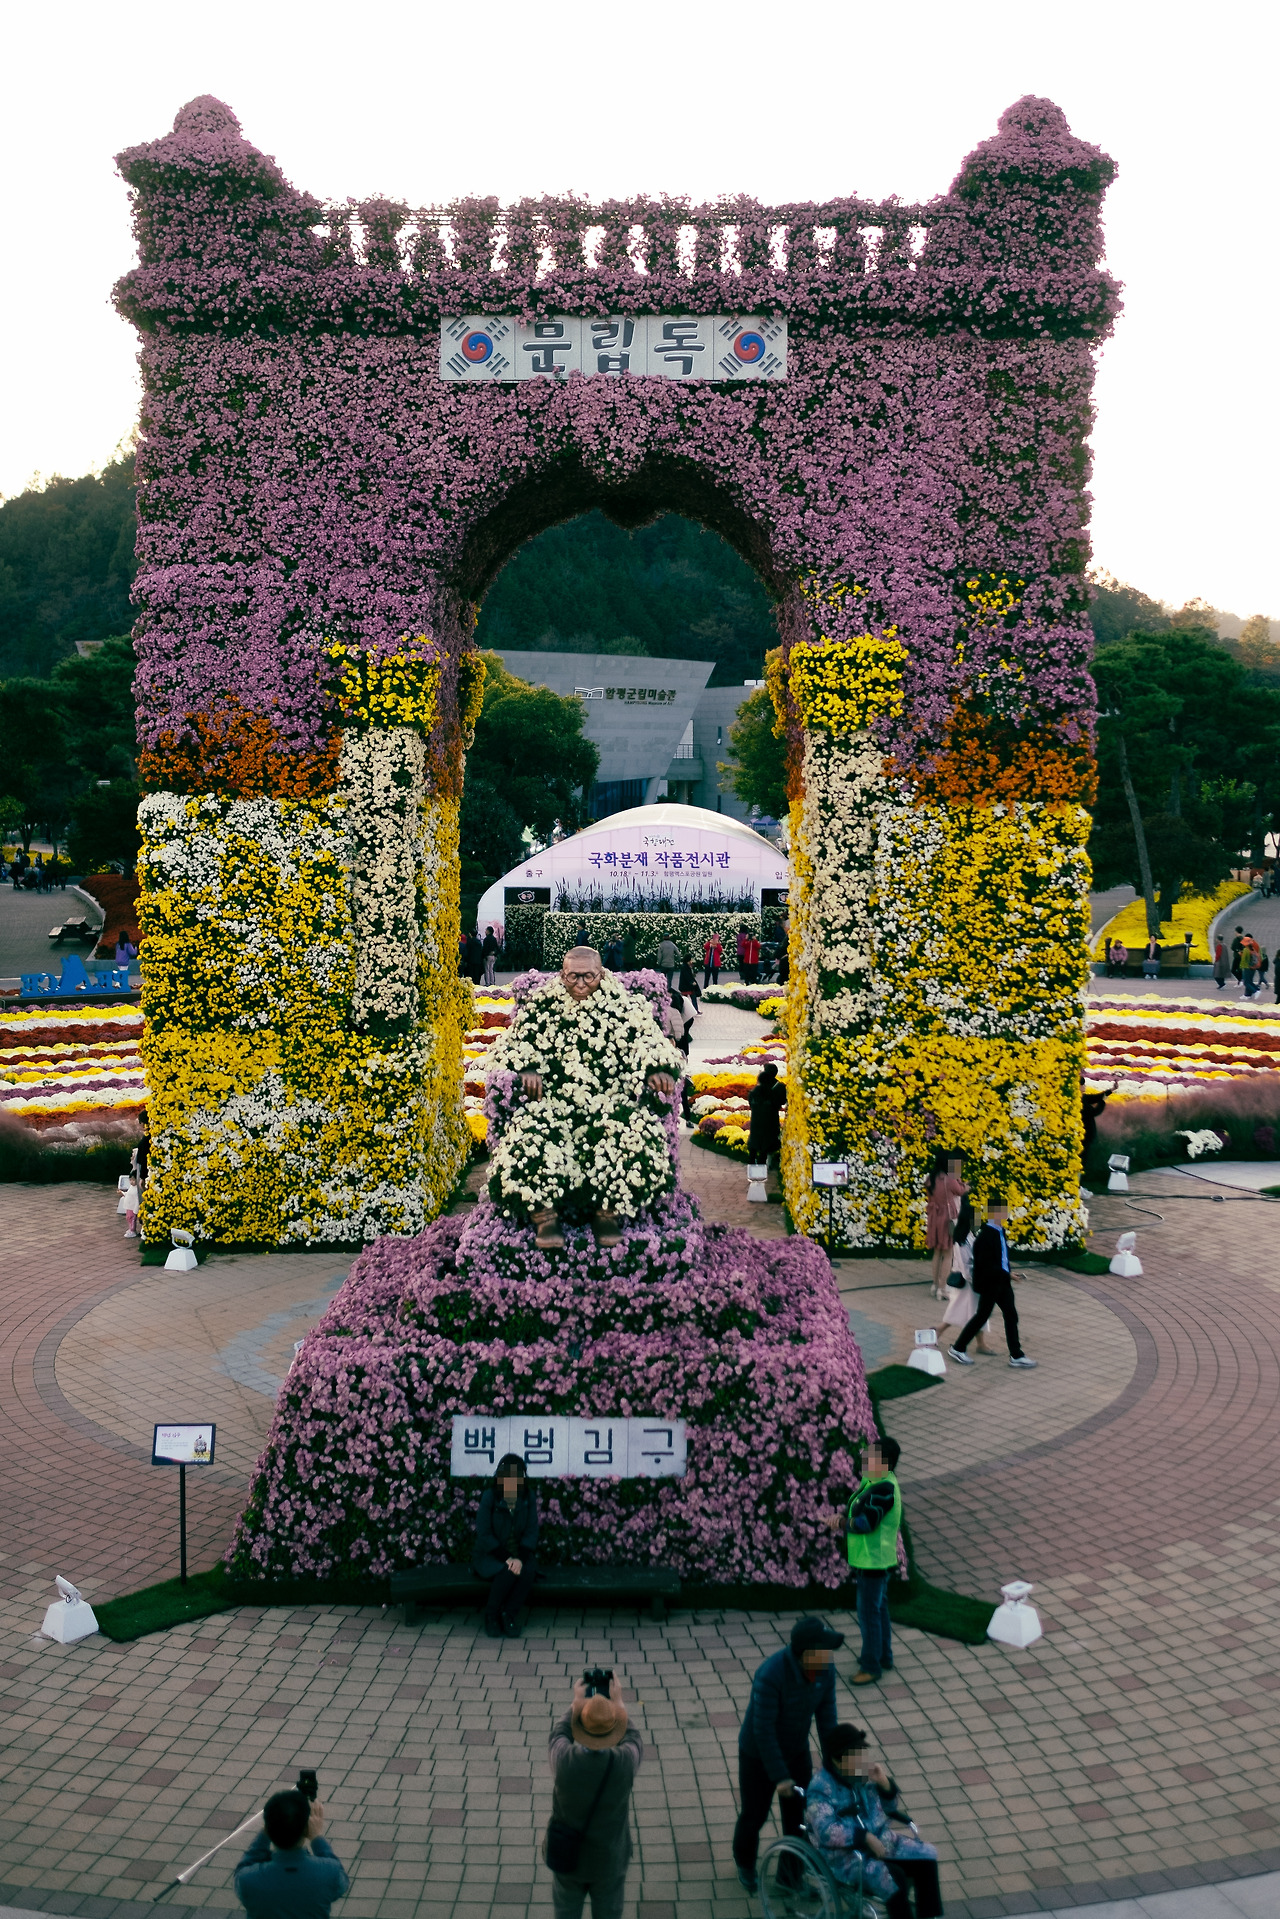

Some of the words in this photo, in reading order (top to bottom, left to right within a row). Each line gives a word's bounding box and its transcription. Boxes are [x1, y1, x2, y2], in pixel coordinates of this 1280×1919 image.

[523, 317, 706, 376] 문립독
[605, 687, 676, 701] 함평군립미술관
[588, 851, 648, 868] 국화분재
[655, 851, 730, 868] 작품전시관
[526, 869, 543, 878] 출구
[464, 1426, 674, 1465] 백범김구
